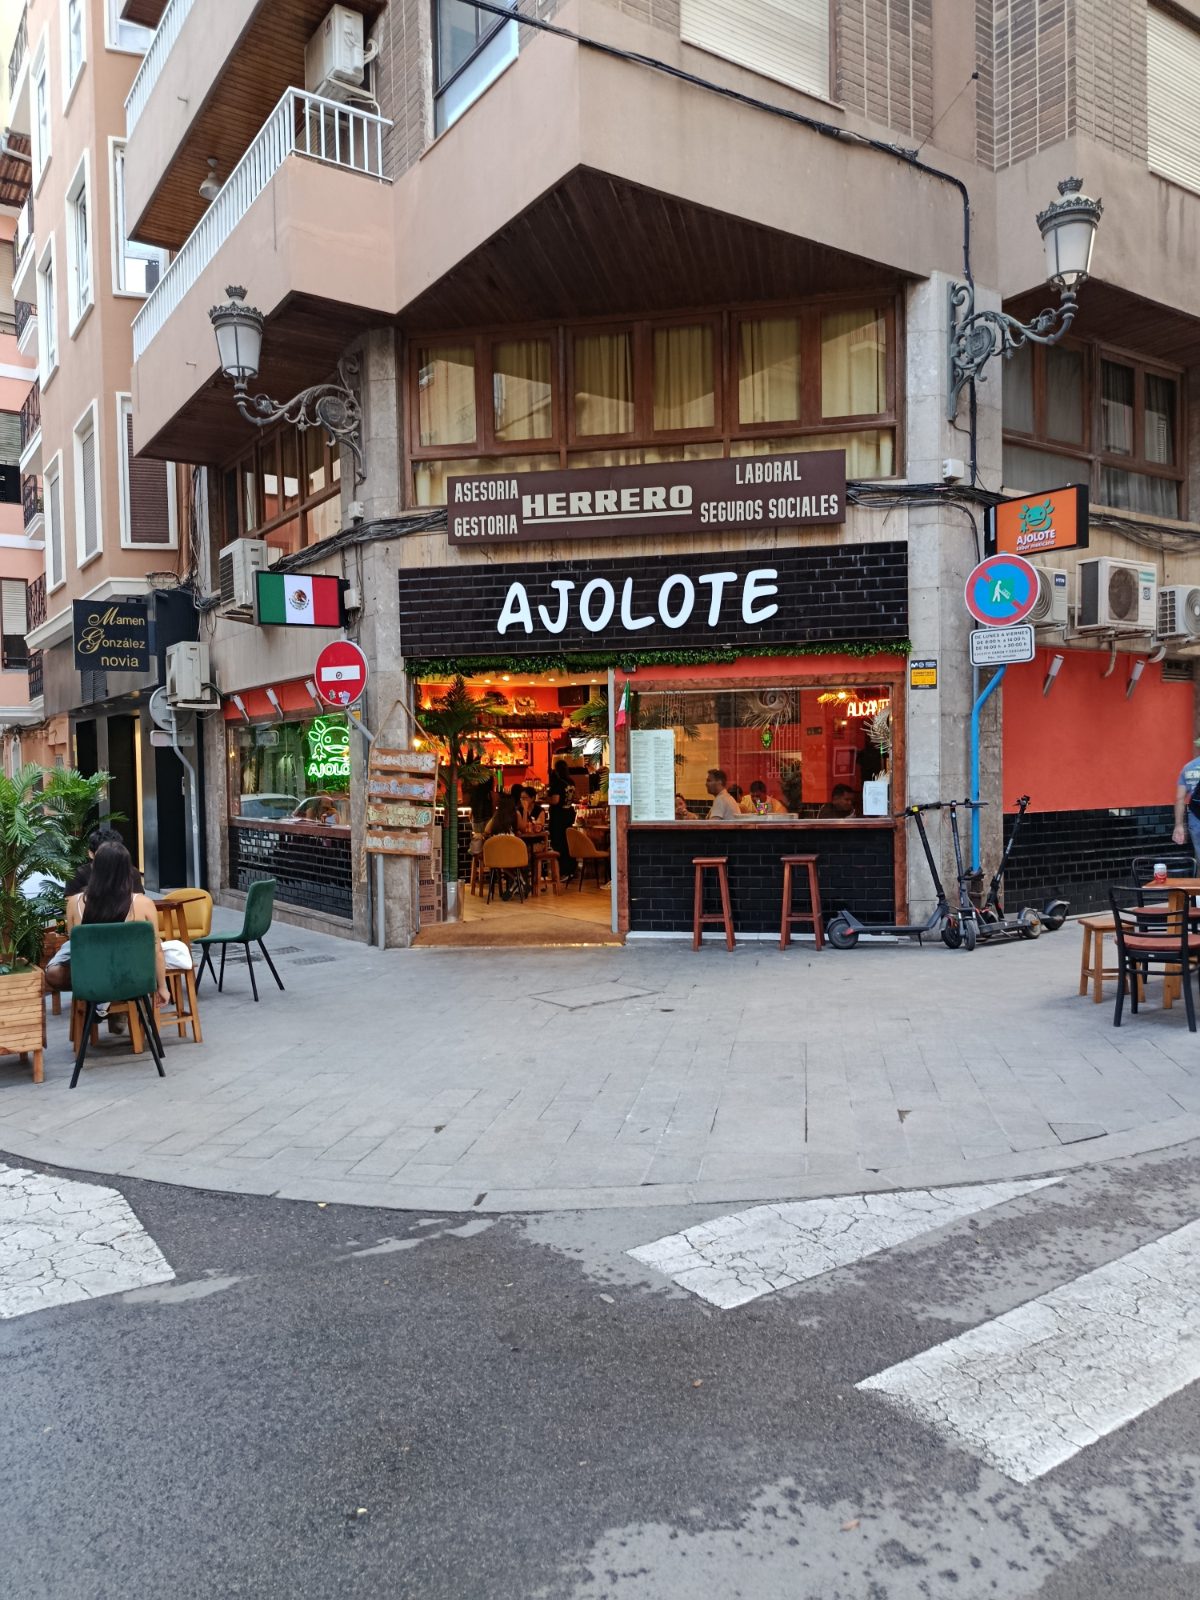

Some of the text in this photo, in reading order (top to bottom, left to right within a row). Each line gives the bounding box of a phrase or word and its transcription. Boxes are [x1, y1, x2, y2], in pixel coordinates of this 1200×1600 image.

[735, 460, 802, 485] LABORAL
[454, 479, 519, 503] ASESORIA
[521, 485, 693, 518] HERRERO
[700, 494, 839, 523] SEGUROS SOCIALES
[454, 515, 518, 537] GESTORIA
[1016, 529, 1056, 545] AJOLOTE
[497, 568, 779, 635] AJOLOTE
[88, 606, 146, 626] Mamen
[77, 626, 146, 654] González
[101, 654, 139, 667] novia
